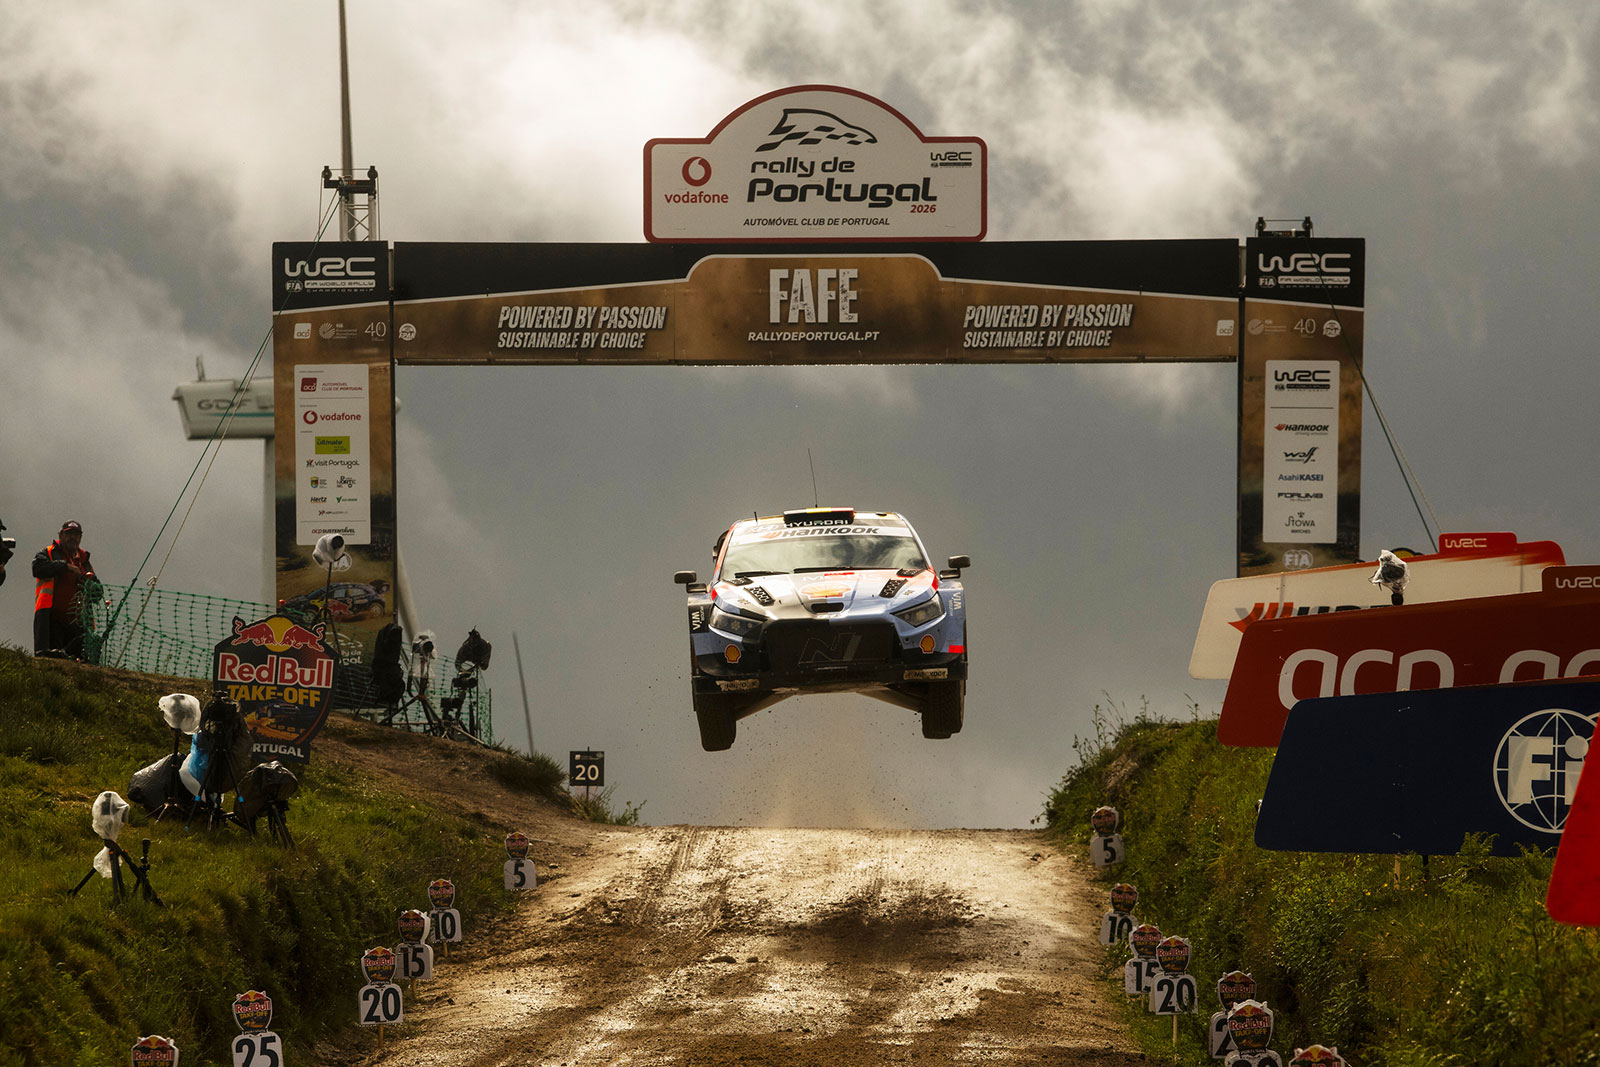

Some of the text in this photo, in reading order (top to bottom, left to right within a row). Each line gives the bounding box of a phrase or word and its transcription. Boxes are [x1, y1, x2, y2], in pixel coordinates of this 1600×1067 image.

[931, 152, 972, 161] WRC
[751, 157, 855, 177] rally de
[664, 191, 729, 203] vodafone
[747, 177, 937, 208] Portugal
[910, 205, 936, 213] 2026
[743, 217, 890, 226] AUTOMÓVEL CLUB DE PORTUGAL
[284, 257, 376, 277] WRC
[1258, 253, 1351, 273] WRC
[769, 268, 858, 323] FAFE
[497, 306, 667, 329] POWERED BY PASSION
[963, 304, 1133, 328] POWERED BY PASSION
[364, 322, 386, 337] 40
[1294, 318, 1316, 334] 40
[497, 332, 646, 349] SUSTAINABLE BY CHOICE
[748, 331, 880, 341] RALLYDEPORTUGAL.PT
[963, 330, 1112, 348] SUSTAINABLE BY CHOICE
[1274, 370, 1331, 382] WRC
[320, 413, 361, 421] vodafone
[328, 460, 359, 469] Portugal
[784, 520, 848, 528] HYUNDAI
[1445, 538, 1487, 548] WRC
[218, 653, 334, 688] Red Bull
[227, 685, 321, 708] TAKE-OFF
[252, 743, 304, 758] RTUGAL
[575, 764, 599, 781] 20
[1104, 838, 1116, 863] 5
[514, 863, 526, 887] 5
[431, 912, 456, 940] 10
[1109, 916, 1133, 943] 10
[400, 947, 425, 977] 15
[1157, 978, 1195, 1012] 20
[1221, 983, 1254, 993] Red Bull
[235, 1001, 270, 1013] Red Bull
[363, 988, 400, 1022] 20
[1229, 1016, 1270, 1030] Red Bull
[134, 1050, 173, 1060] Red Bull
[235, 1036, 279, 1067] 25
